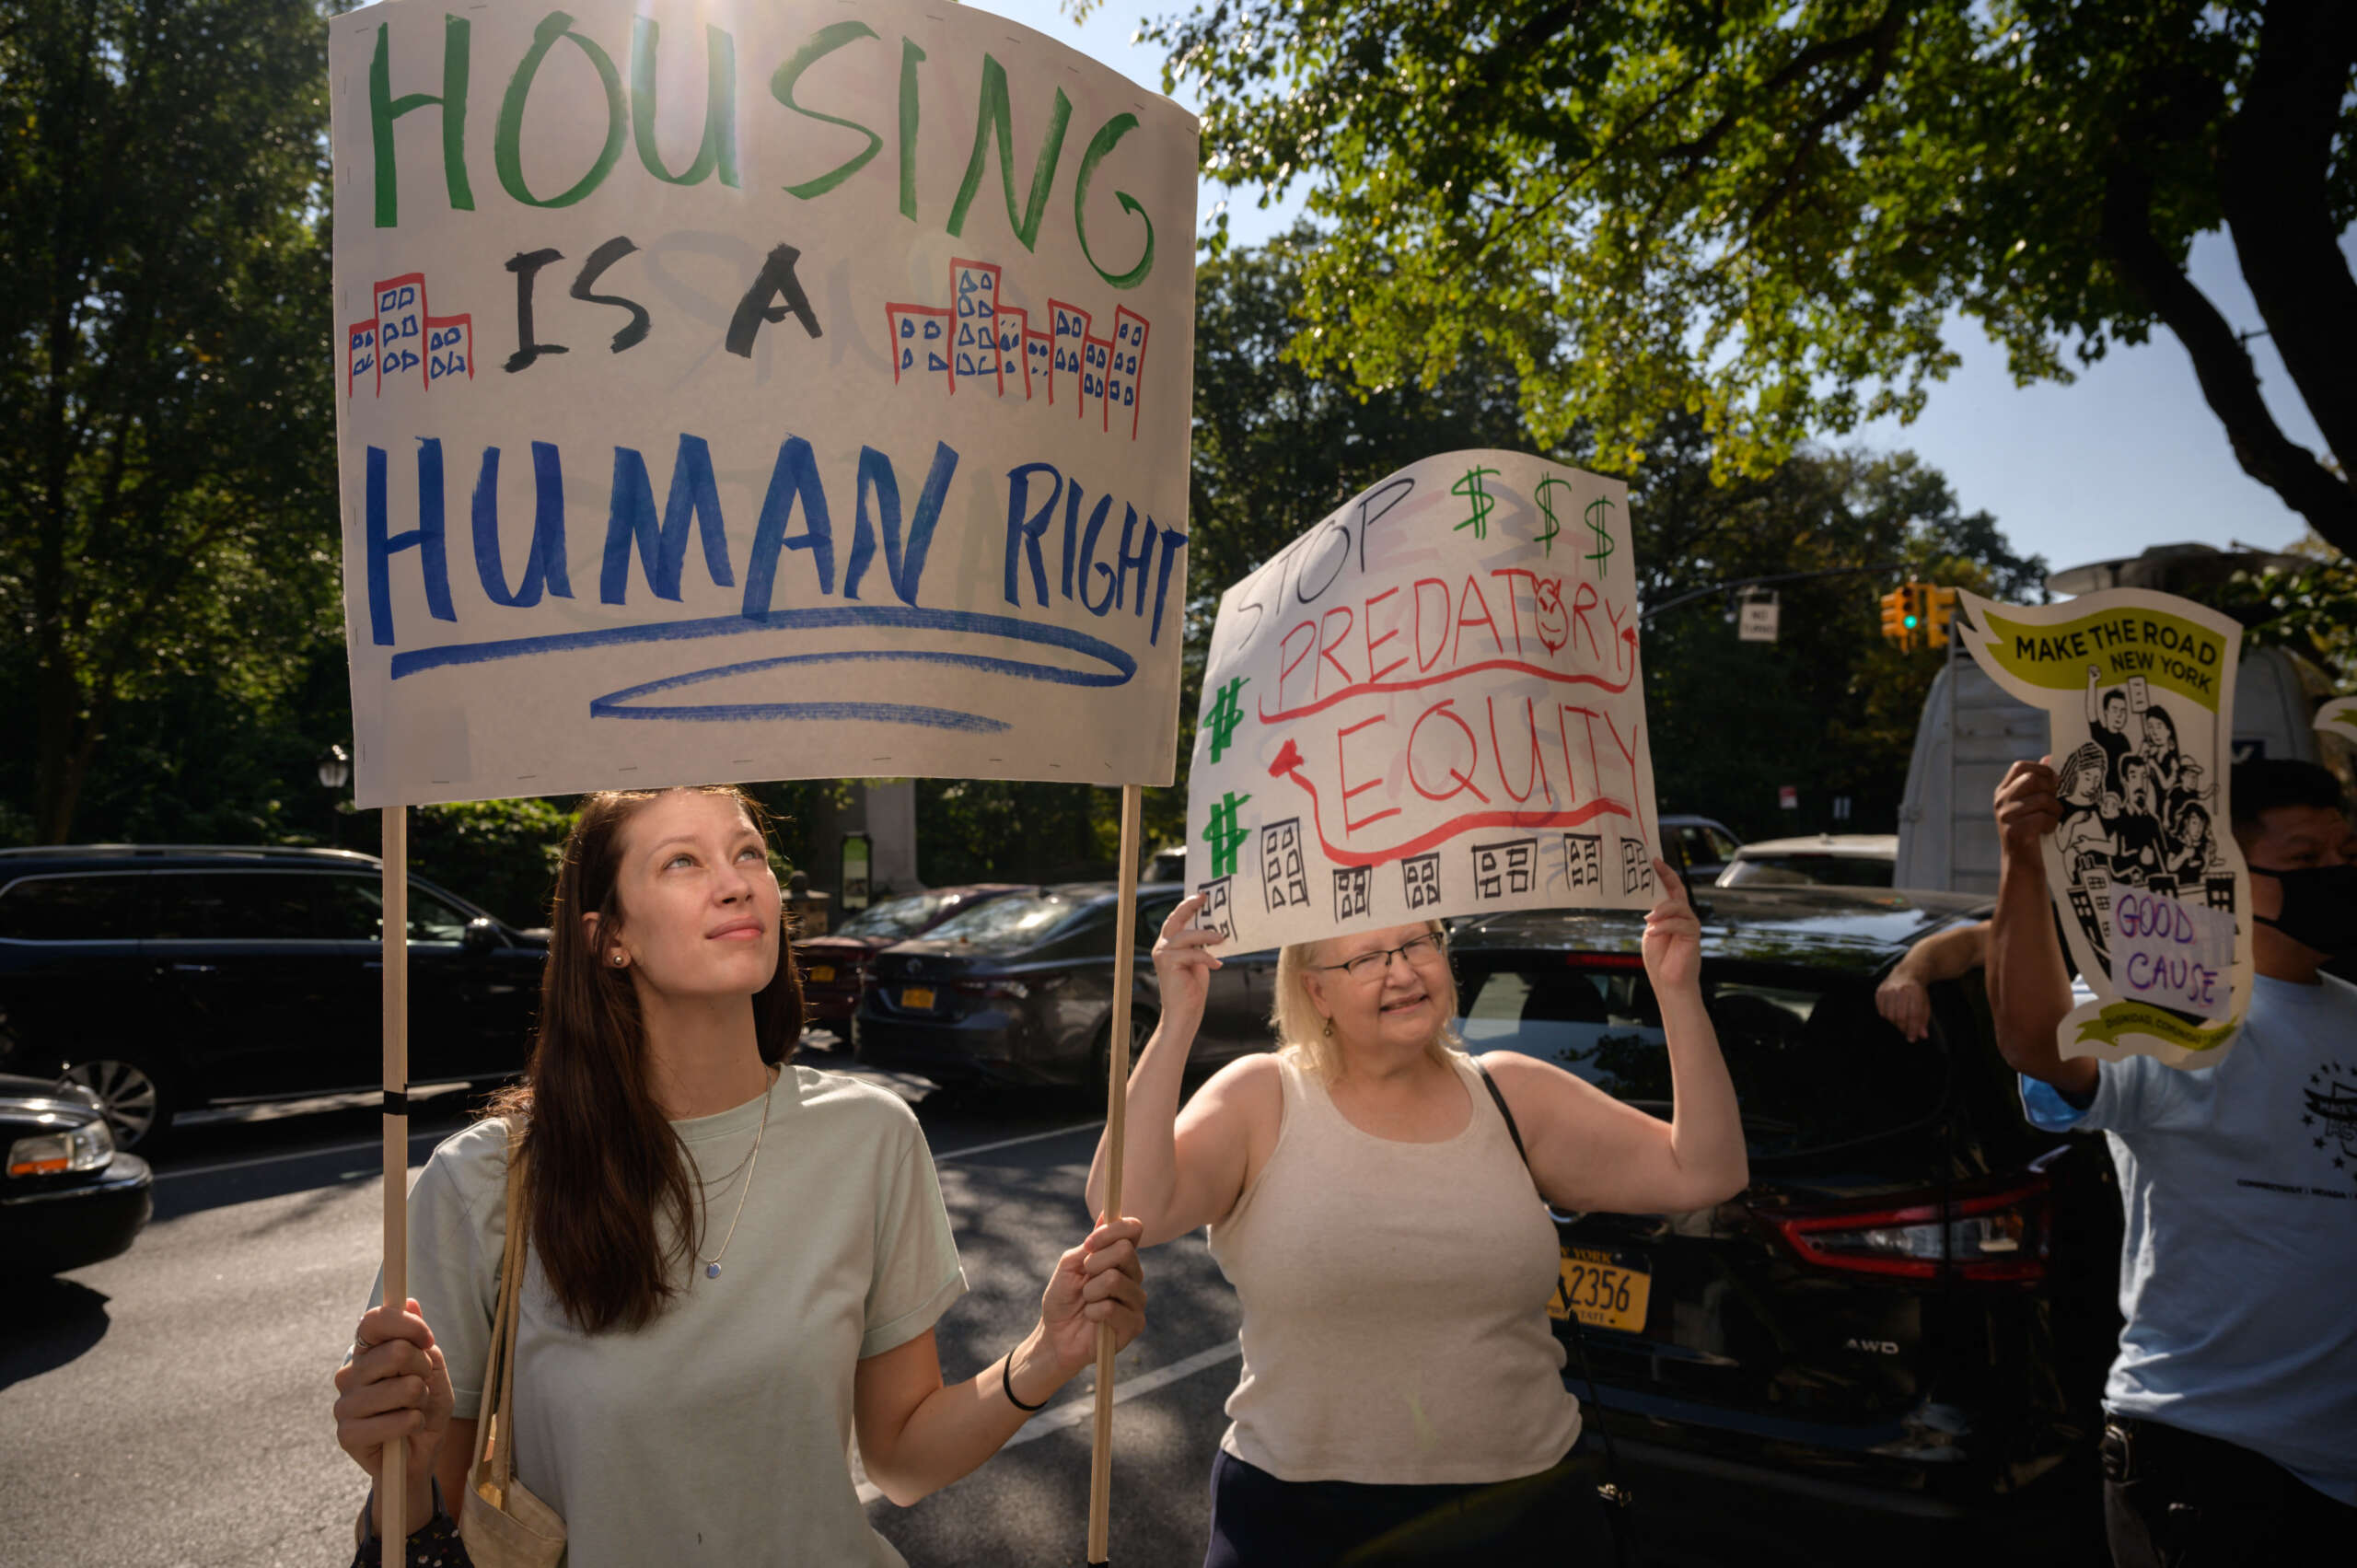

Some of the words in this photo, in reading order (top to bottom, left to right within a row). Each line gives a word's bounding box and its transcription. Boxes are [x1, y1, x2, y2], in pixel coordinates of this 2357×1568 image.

[369, 8, 1155, 290] HOUSING
[501, 235, 651, 373] IS
[726, 242, 823, 358] A
[366, 432, 959, 646] HUMAN
[1004, 462, 1189, 647] RIGHT
[1237, 478, 1416, 651] STOP
[2015, 633, 2088, 662] MAKE
[2088, 619, 2137, 650] THE
[2142, 621, 2217, 666] ROAD
[2110, 650, 2154, 673] NEW
[2160, 655, 2212, 693] YORK
[1337, 695, 1649, 846] EQUITY
[2117, 893, 2196, 945] GOOD
[2127, 952, 2218, 1007] CAUSE
[1571, 1265, 1631, 1313] 2356
[1845, 1338, 1899, 1355] AWD
